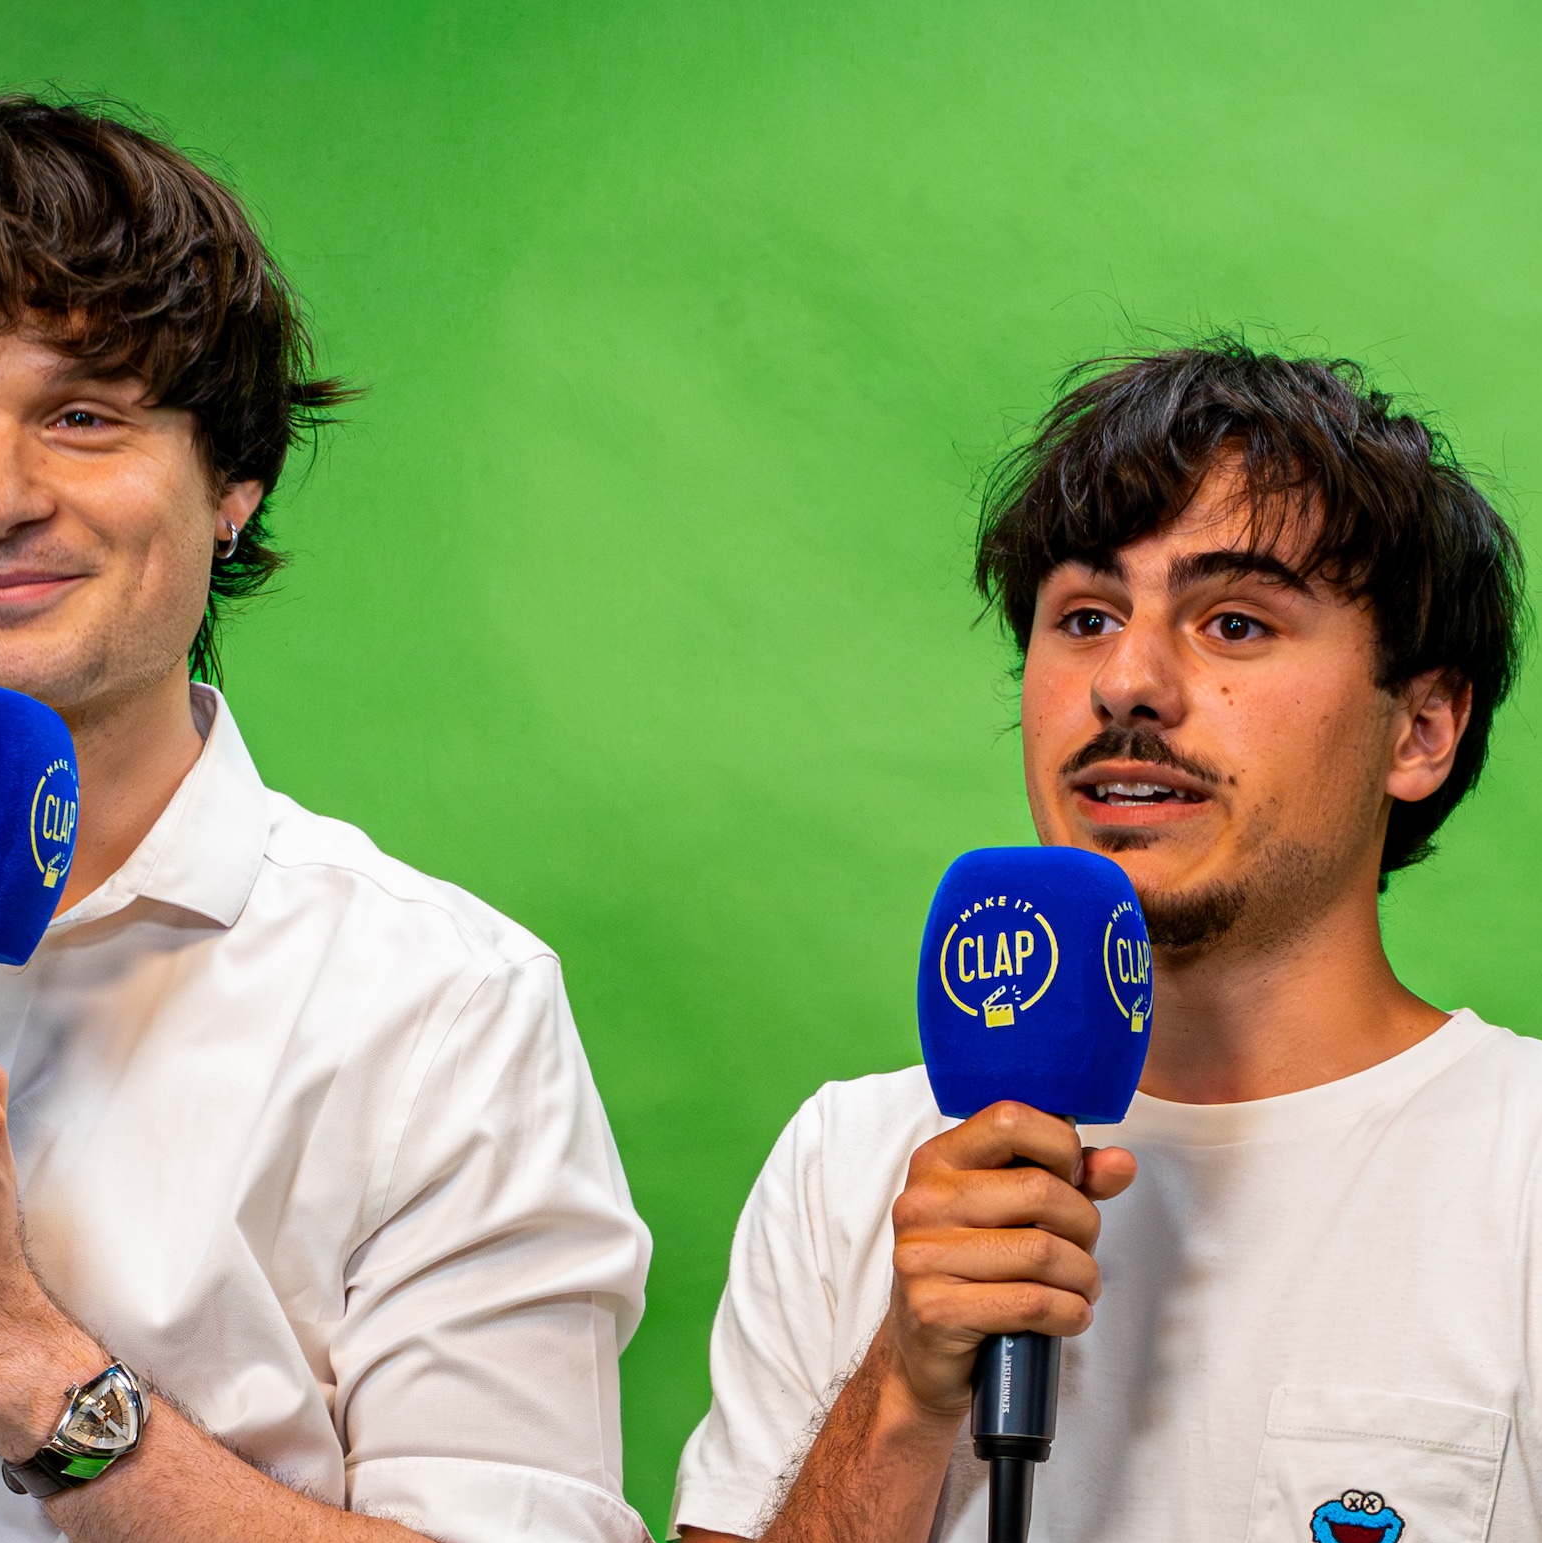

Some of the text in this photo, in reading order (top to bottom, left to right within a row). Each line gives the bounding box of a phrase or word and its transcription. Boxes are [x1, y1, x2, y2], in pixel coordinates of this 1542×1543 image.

[46, 758, 69, 778] MAKE
[42, 793, 77, 845] CLAP
[959, 895, 1034, 922] MAKE IT
[958, 930, 1035, 983] CLAP
[1116, 937, 1150, 985] CLAP
[1001, 1354, 1013, 1415] SENNHEISER
